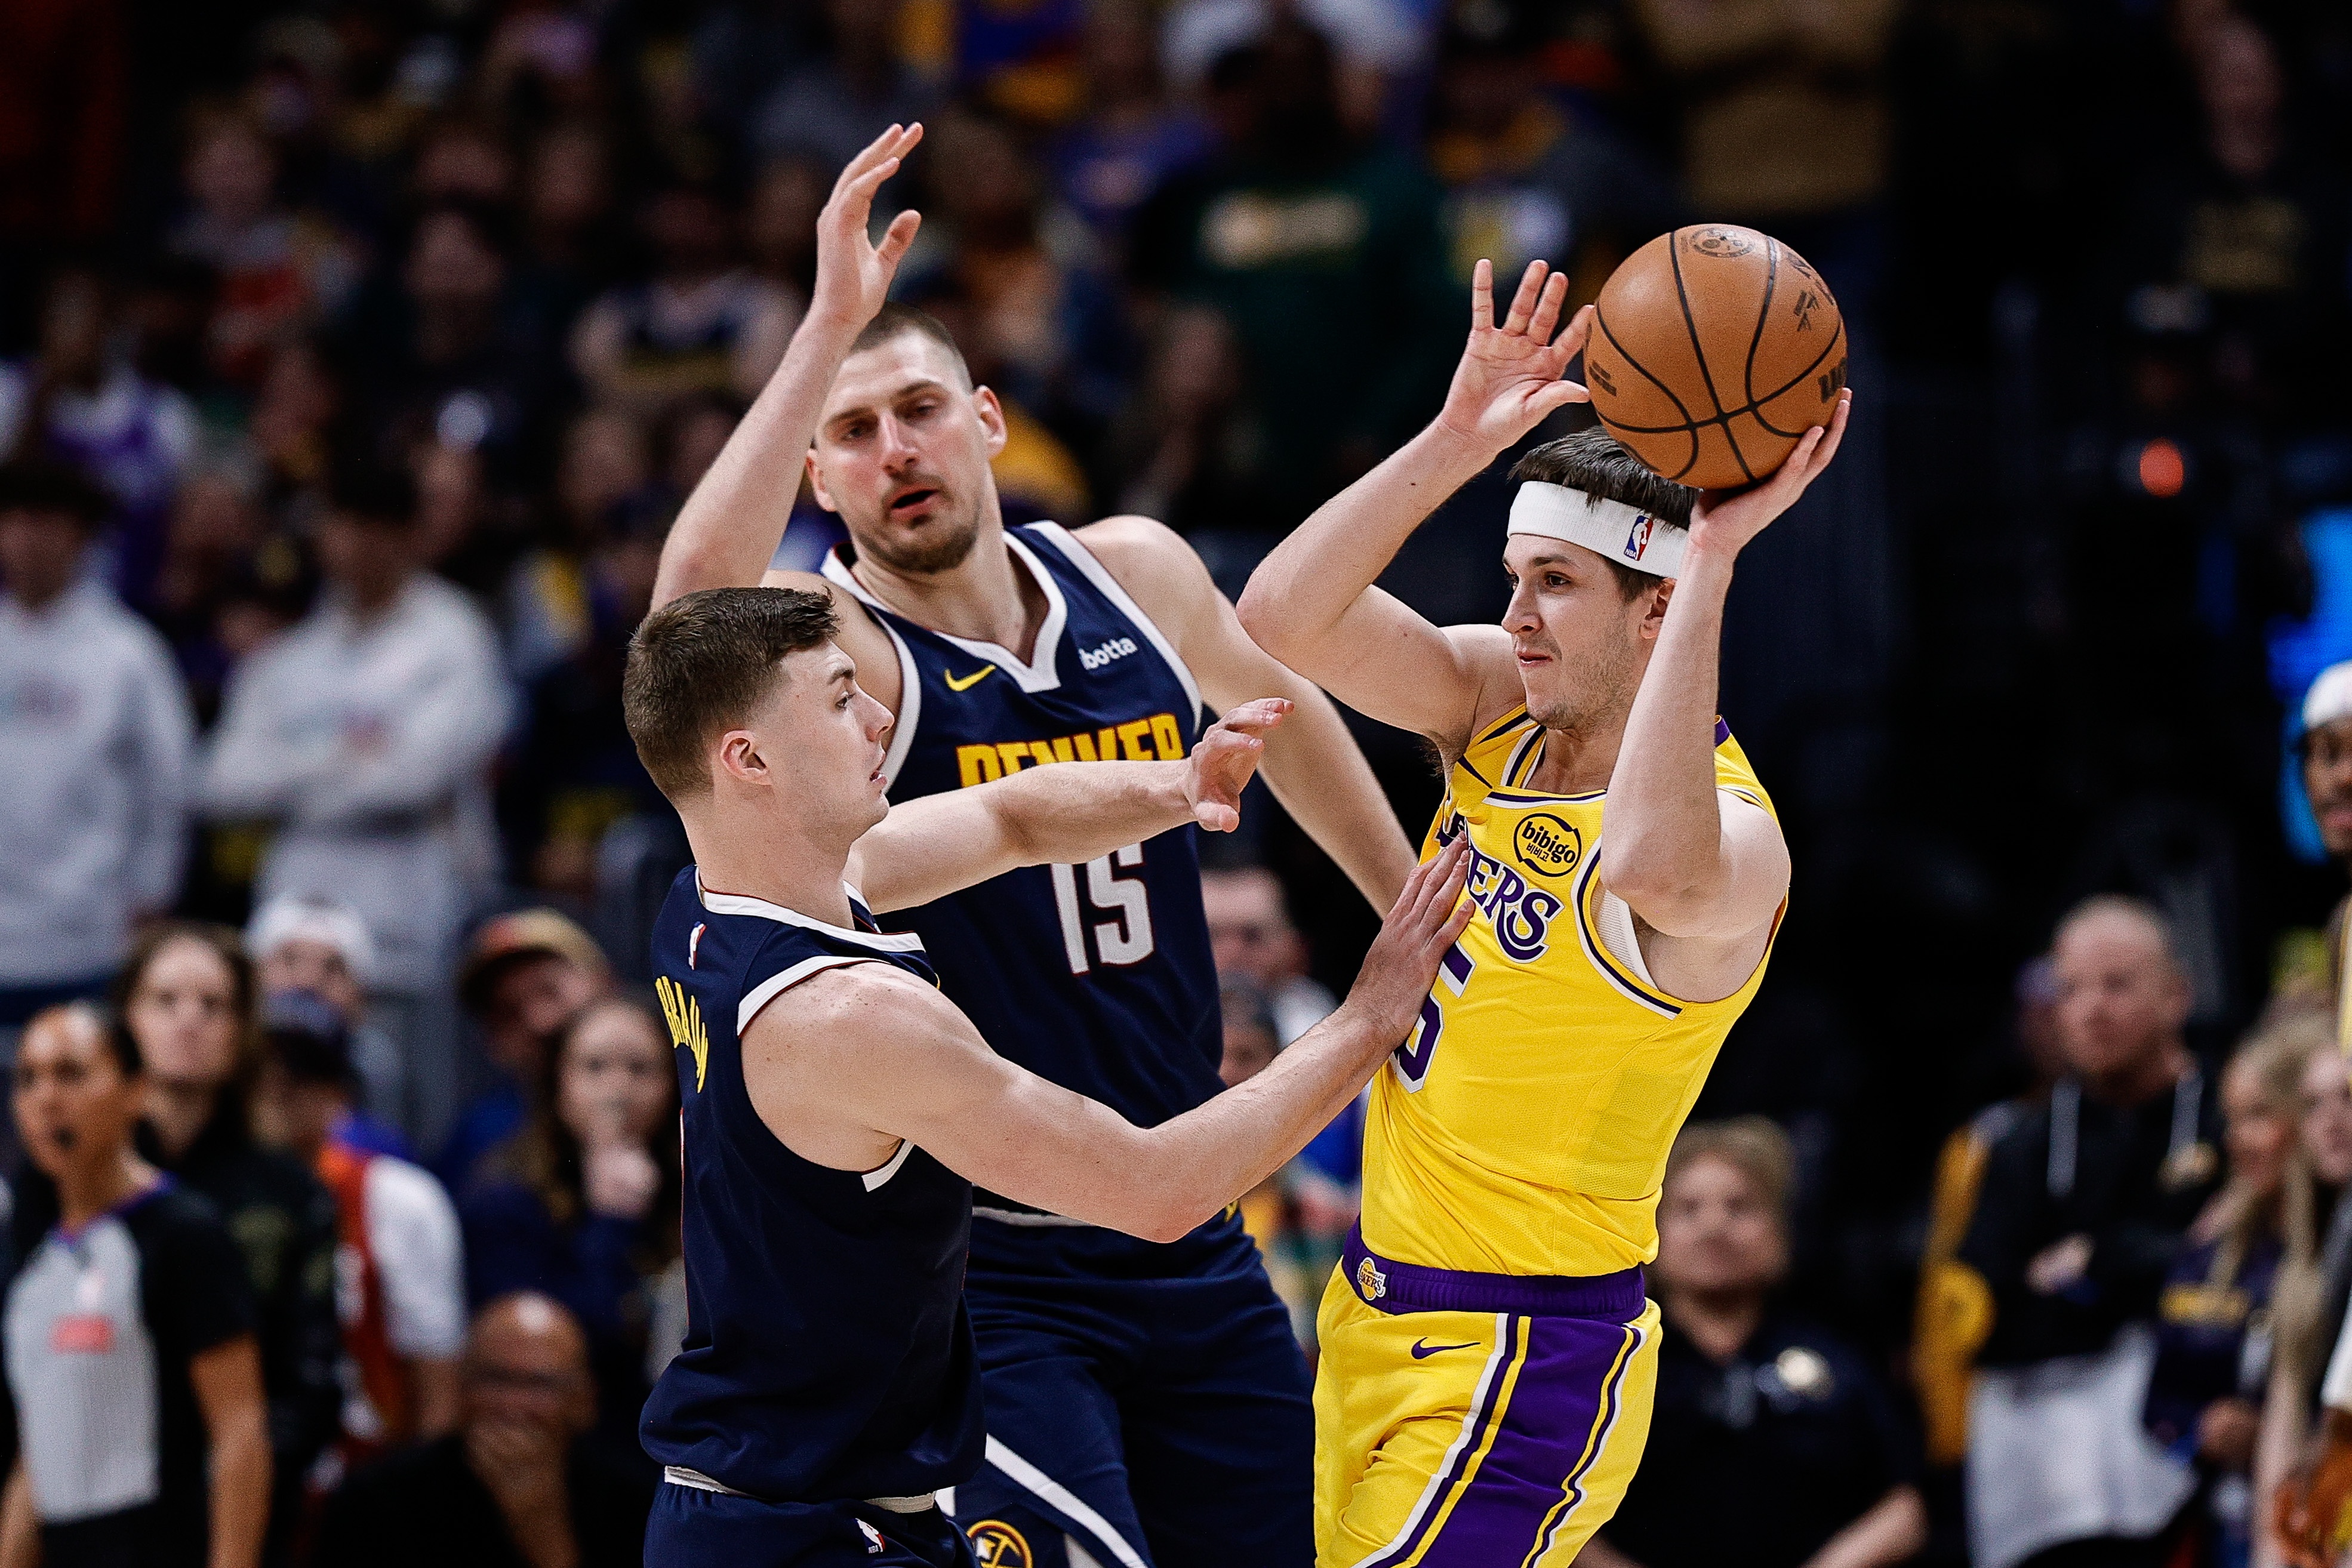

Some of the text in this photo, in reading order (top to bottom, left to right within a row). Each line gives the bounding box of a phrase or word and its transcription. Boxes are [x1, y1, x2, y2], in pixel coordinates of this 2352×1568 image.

[1624, 548, 1637, 559] NBA
[1521, 820, 1576, 864] bibigo
[1525, 842, 1550, 862] 비비고
[1050, 841, 1155, 975] 15
